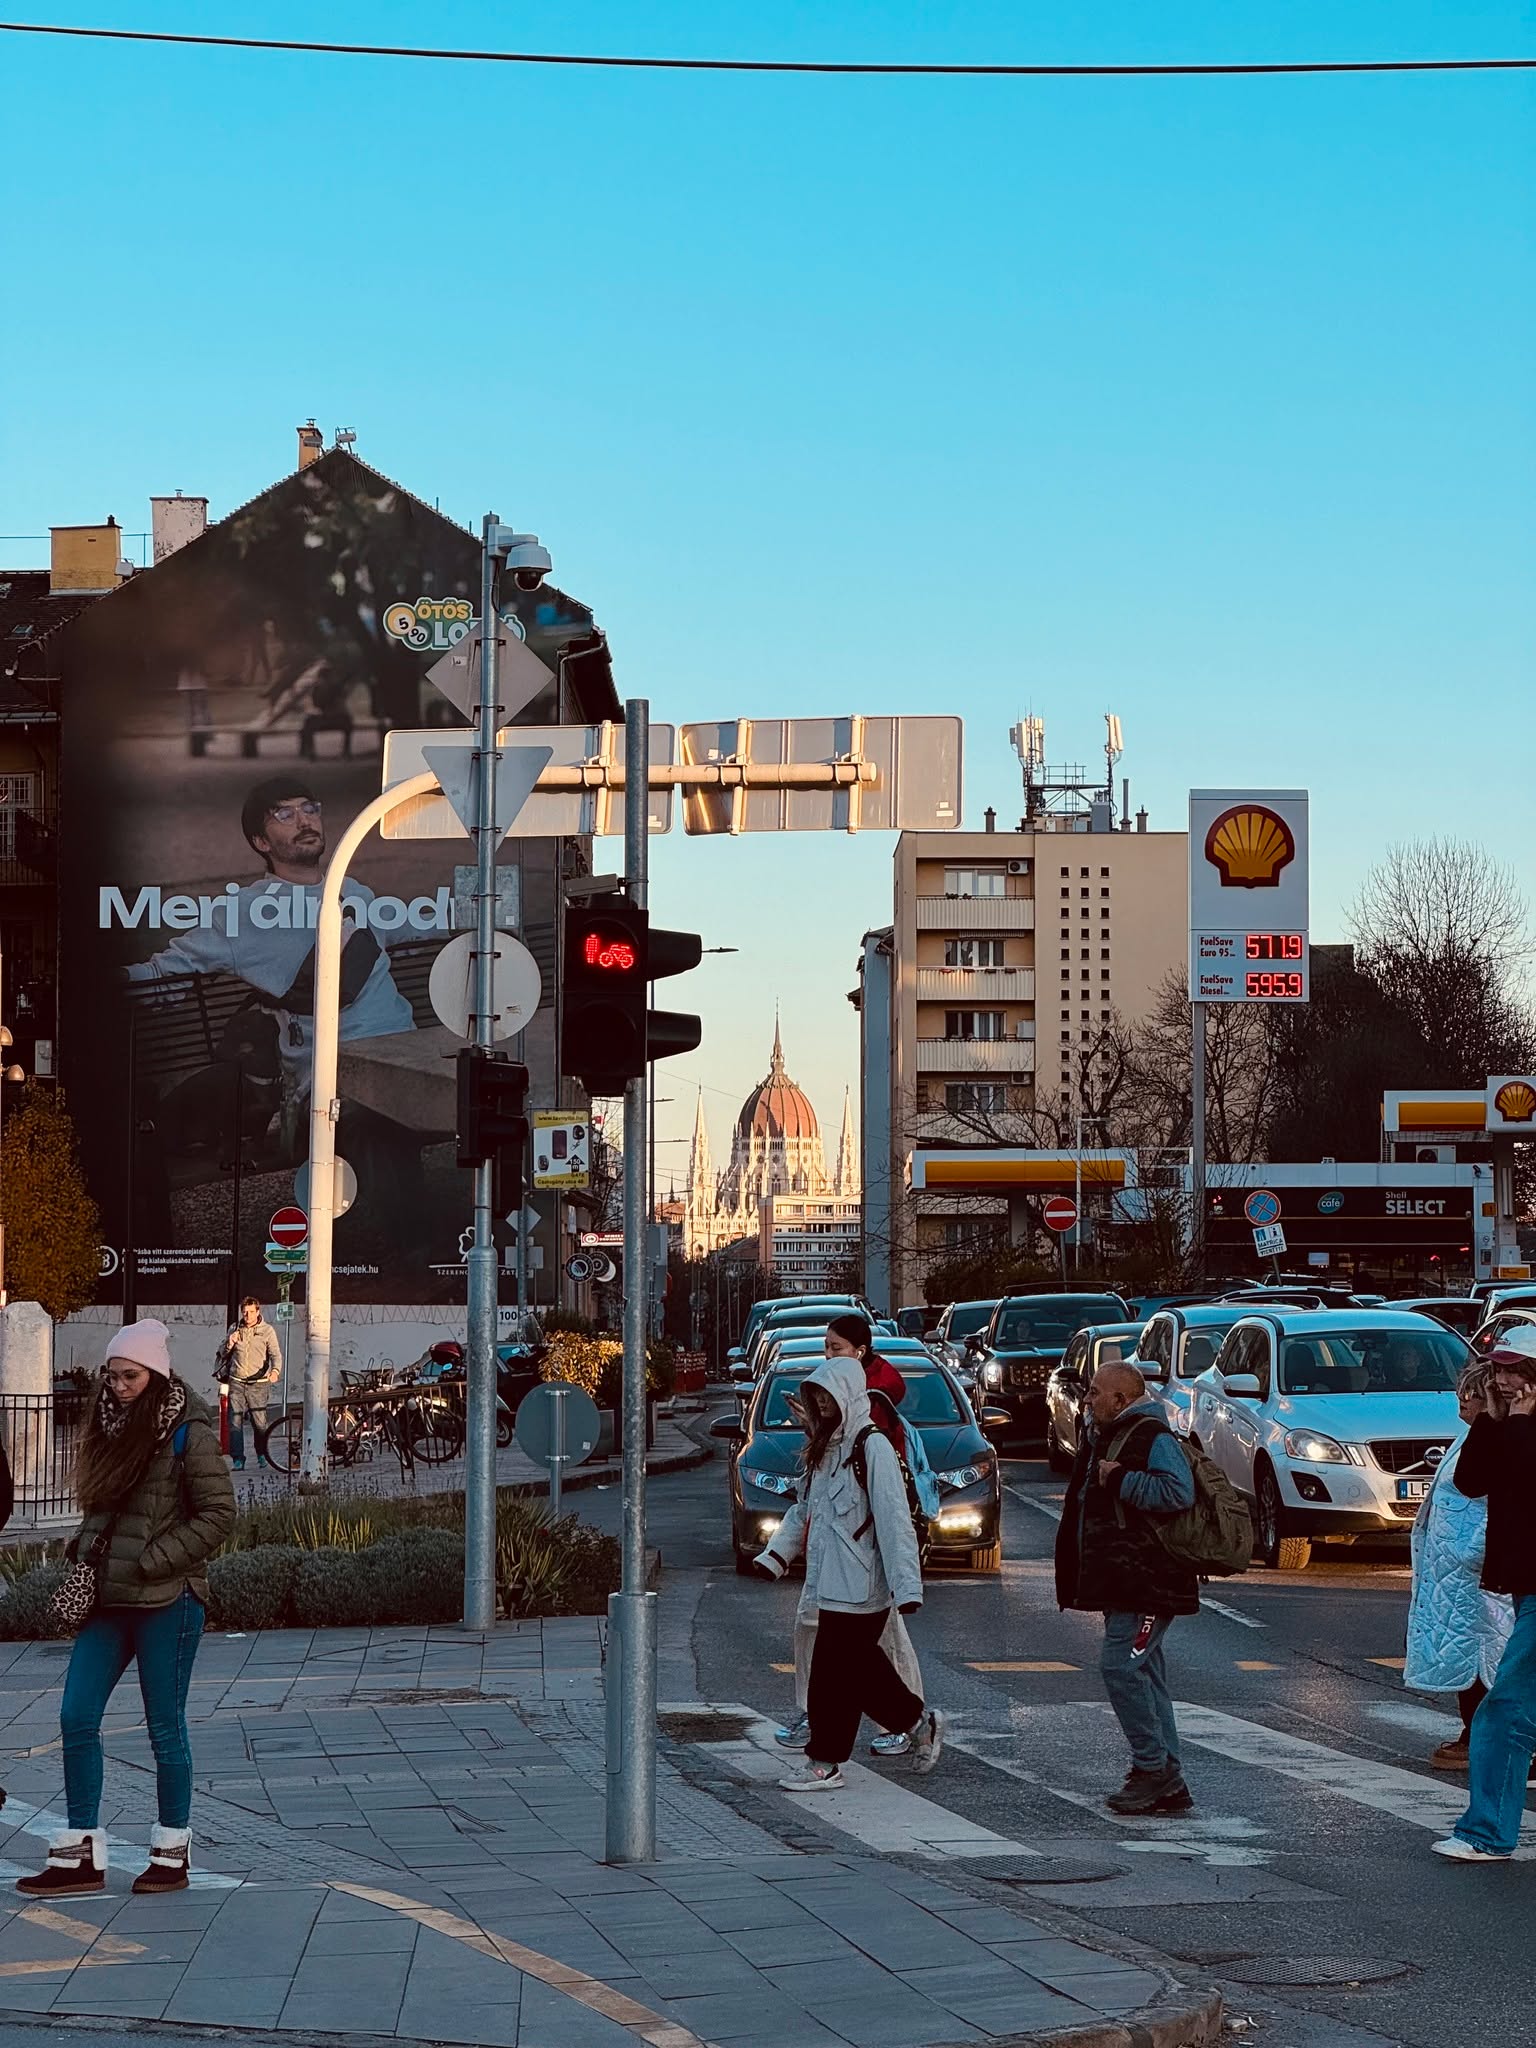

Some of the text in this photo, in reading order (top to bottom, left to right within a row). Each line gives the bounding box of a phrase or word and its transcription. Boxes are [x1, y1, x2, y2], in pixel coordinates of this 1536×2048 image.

[398, 617, 409, 630] 5
[409, 628, 426, 643] 90
[99, 882, 456, 938] Merj álmod
[1200, 936, 1234, 946] FuelSave
[1247, 935, 1301, 958] 571.9
[1200, 948, 1217, 957] Euro
[1219, 948, 1229, 957] 95
[1200, 974, 1234, 984] FuelSave
[1247, 973, 1301, 996] 595.9
[1200, 985, 1223, 995] Diesel
[1385, 1191, 1407, 1199] Shell
[1385, 1200, 1446, 1215] SELECT
[1411, 1483, 1430, 1495] LP
[1142, 1615, 1155, 1633] TIC
